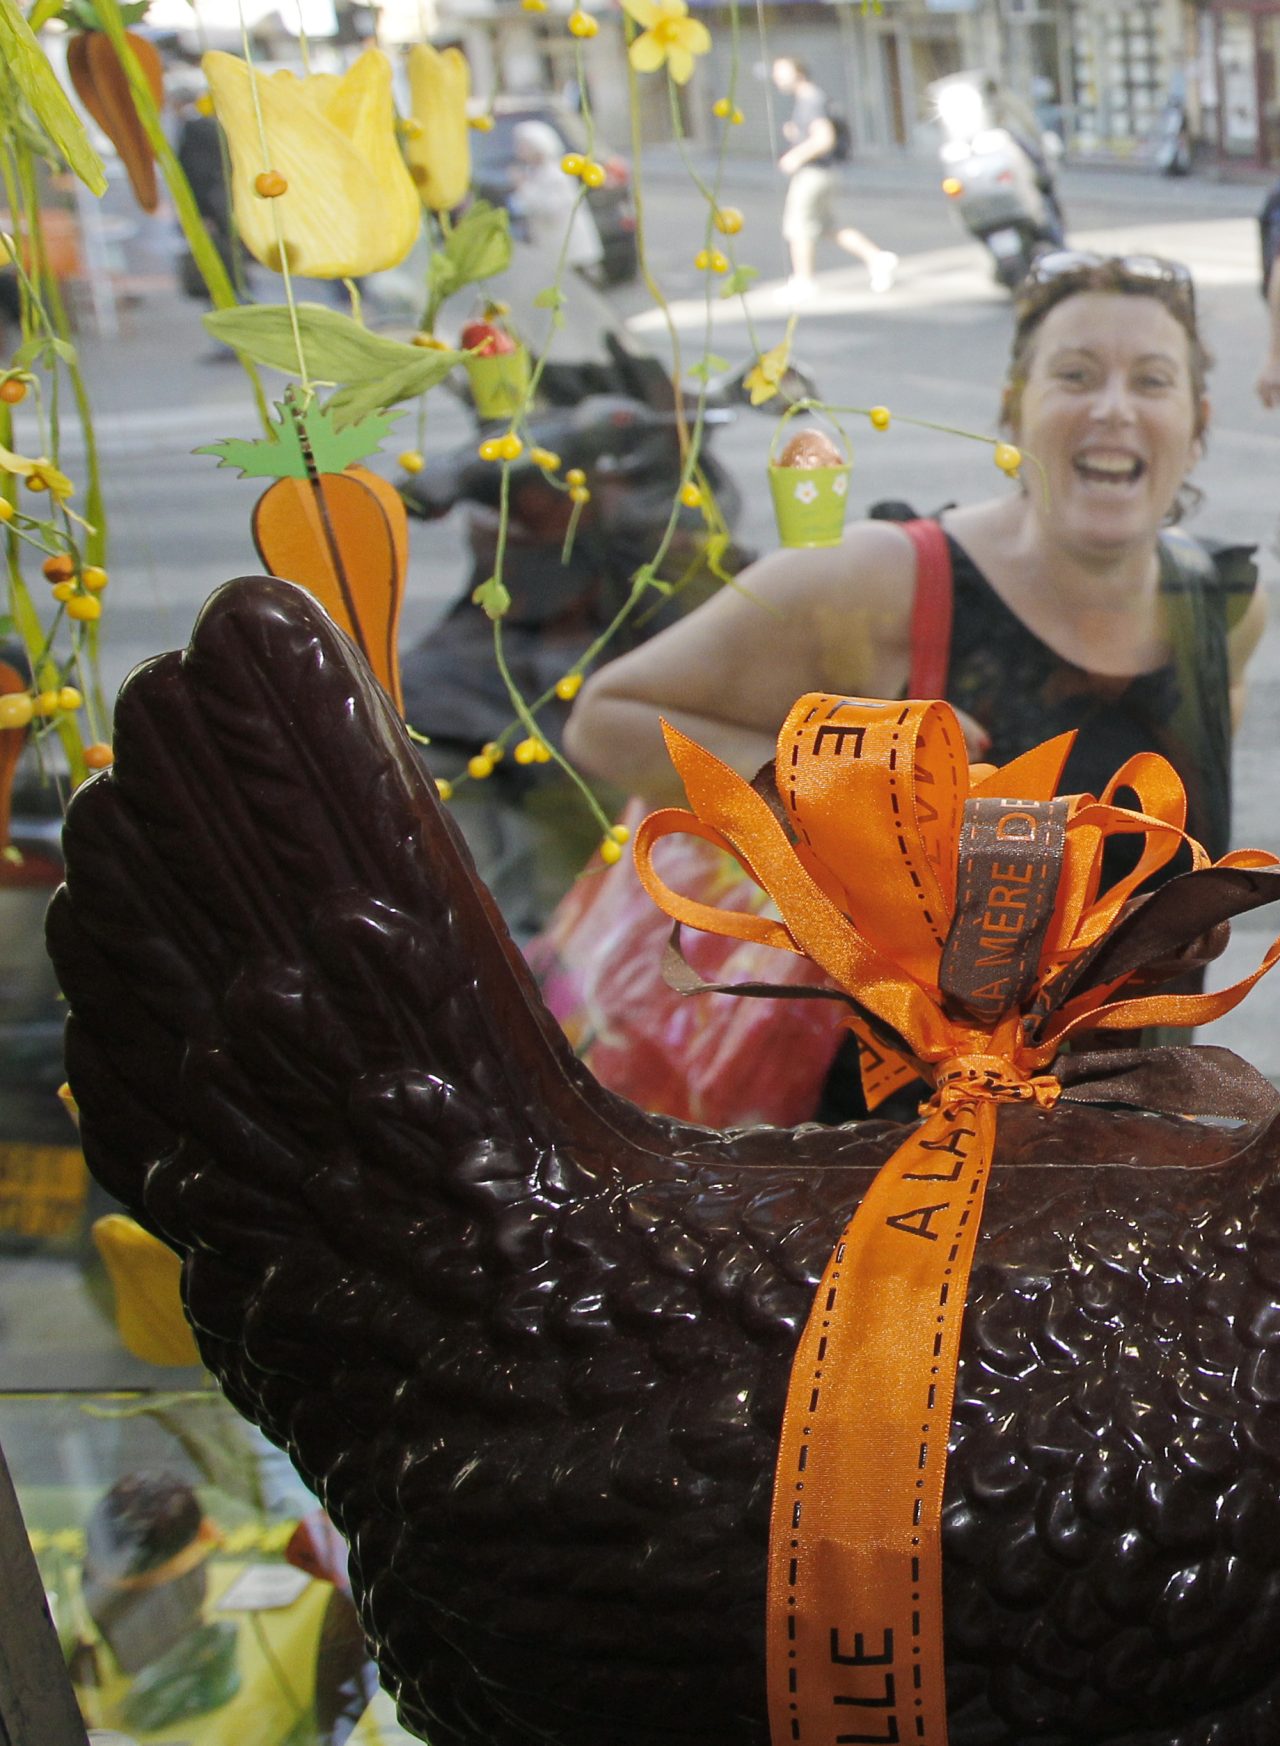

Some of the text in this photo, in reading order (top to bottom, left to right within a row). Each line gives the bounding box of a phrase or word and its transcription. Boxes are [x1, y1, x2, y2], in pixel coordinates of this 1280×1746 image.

[973, 861, 1034, 967] MÈRE
[902, 1128, 977, 1182] LA
[885, 1202, 951, 1241] A
